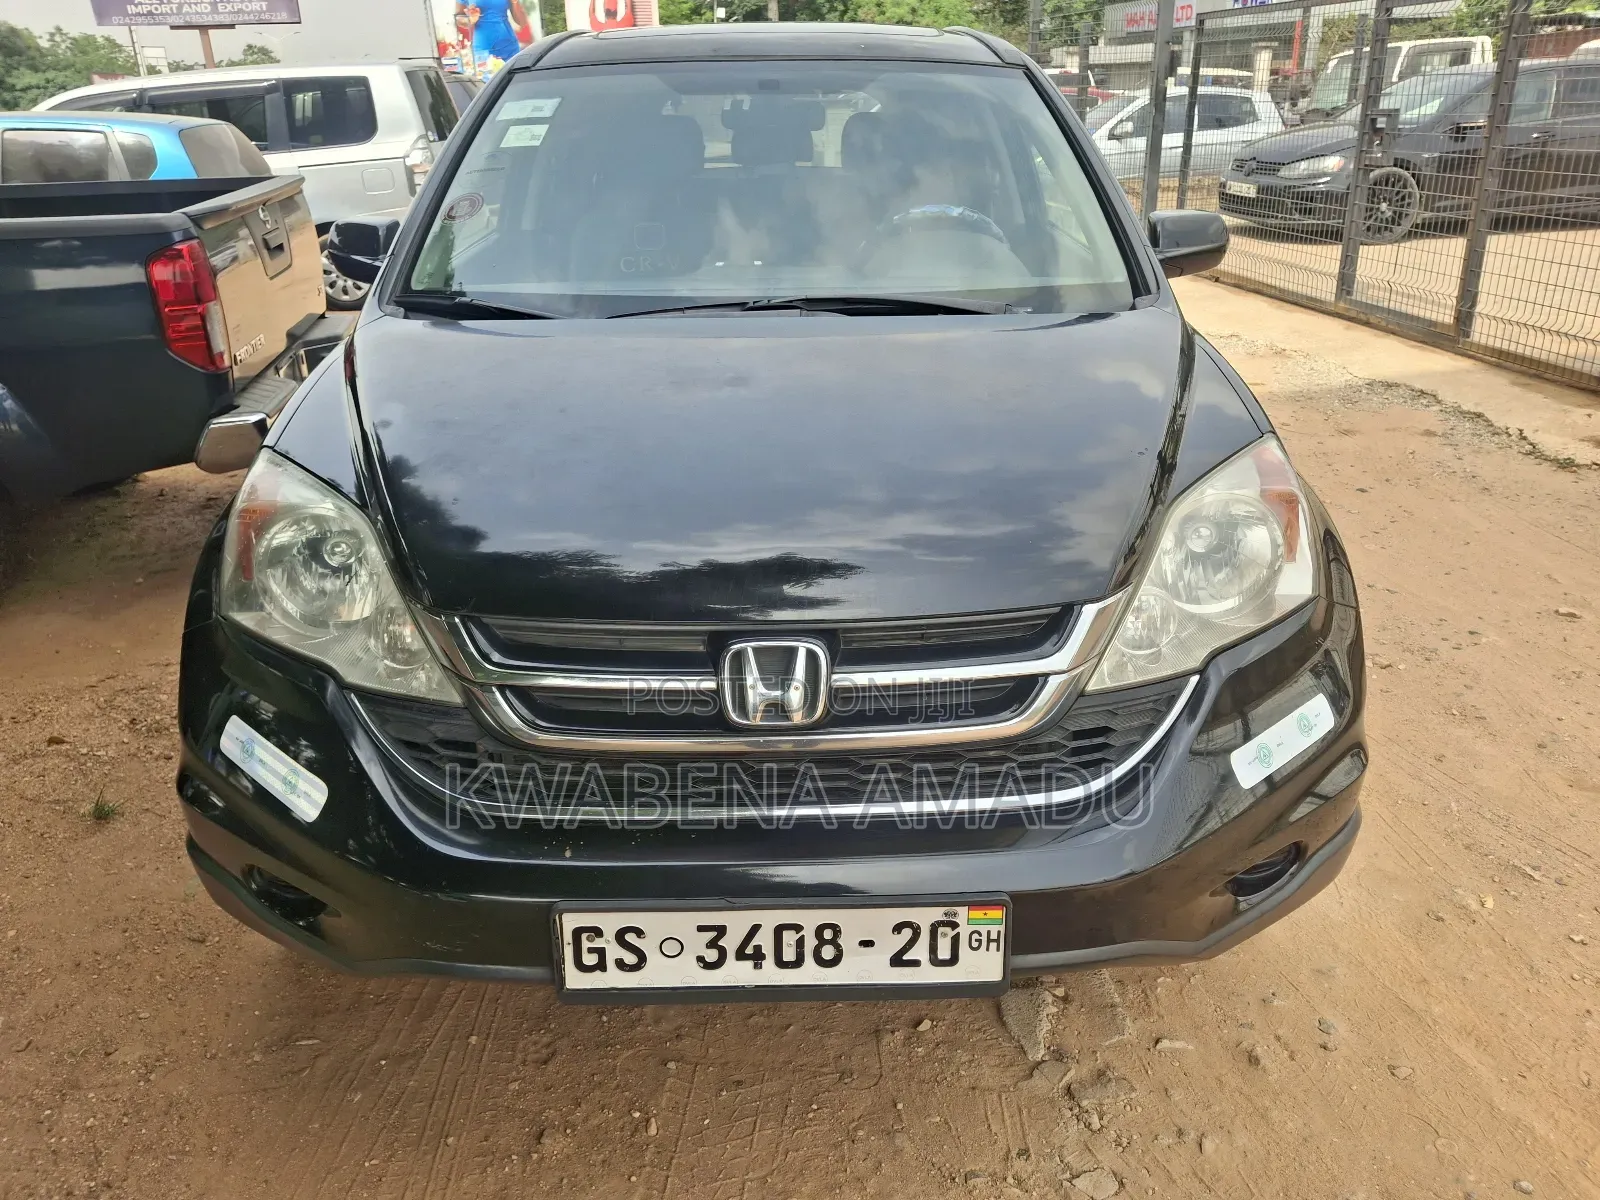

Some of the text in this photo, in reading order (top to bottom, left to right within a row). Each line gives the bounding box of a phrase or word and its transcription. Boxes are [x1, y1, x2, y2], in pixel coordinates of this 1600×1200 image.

[126, 2, 269, 14] IMPORT AND EXPORT
[1175, 4, 1193, 23] LTD
[571, 925, 647, 974] GS
[968, 929, 1001, 953] GH
